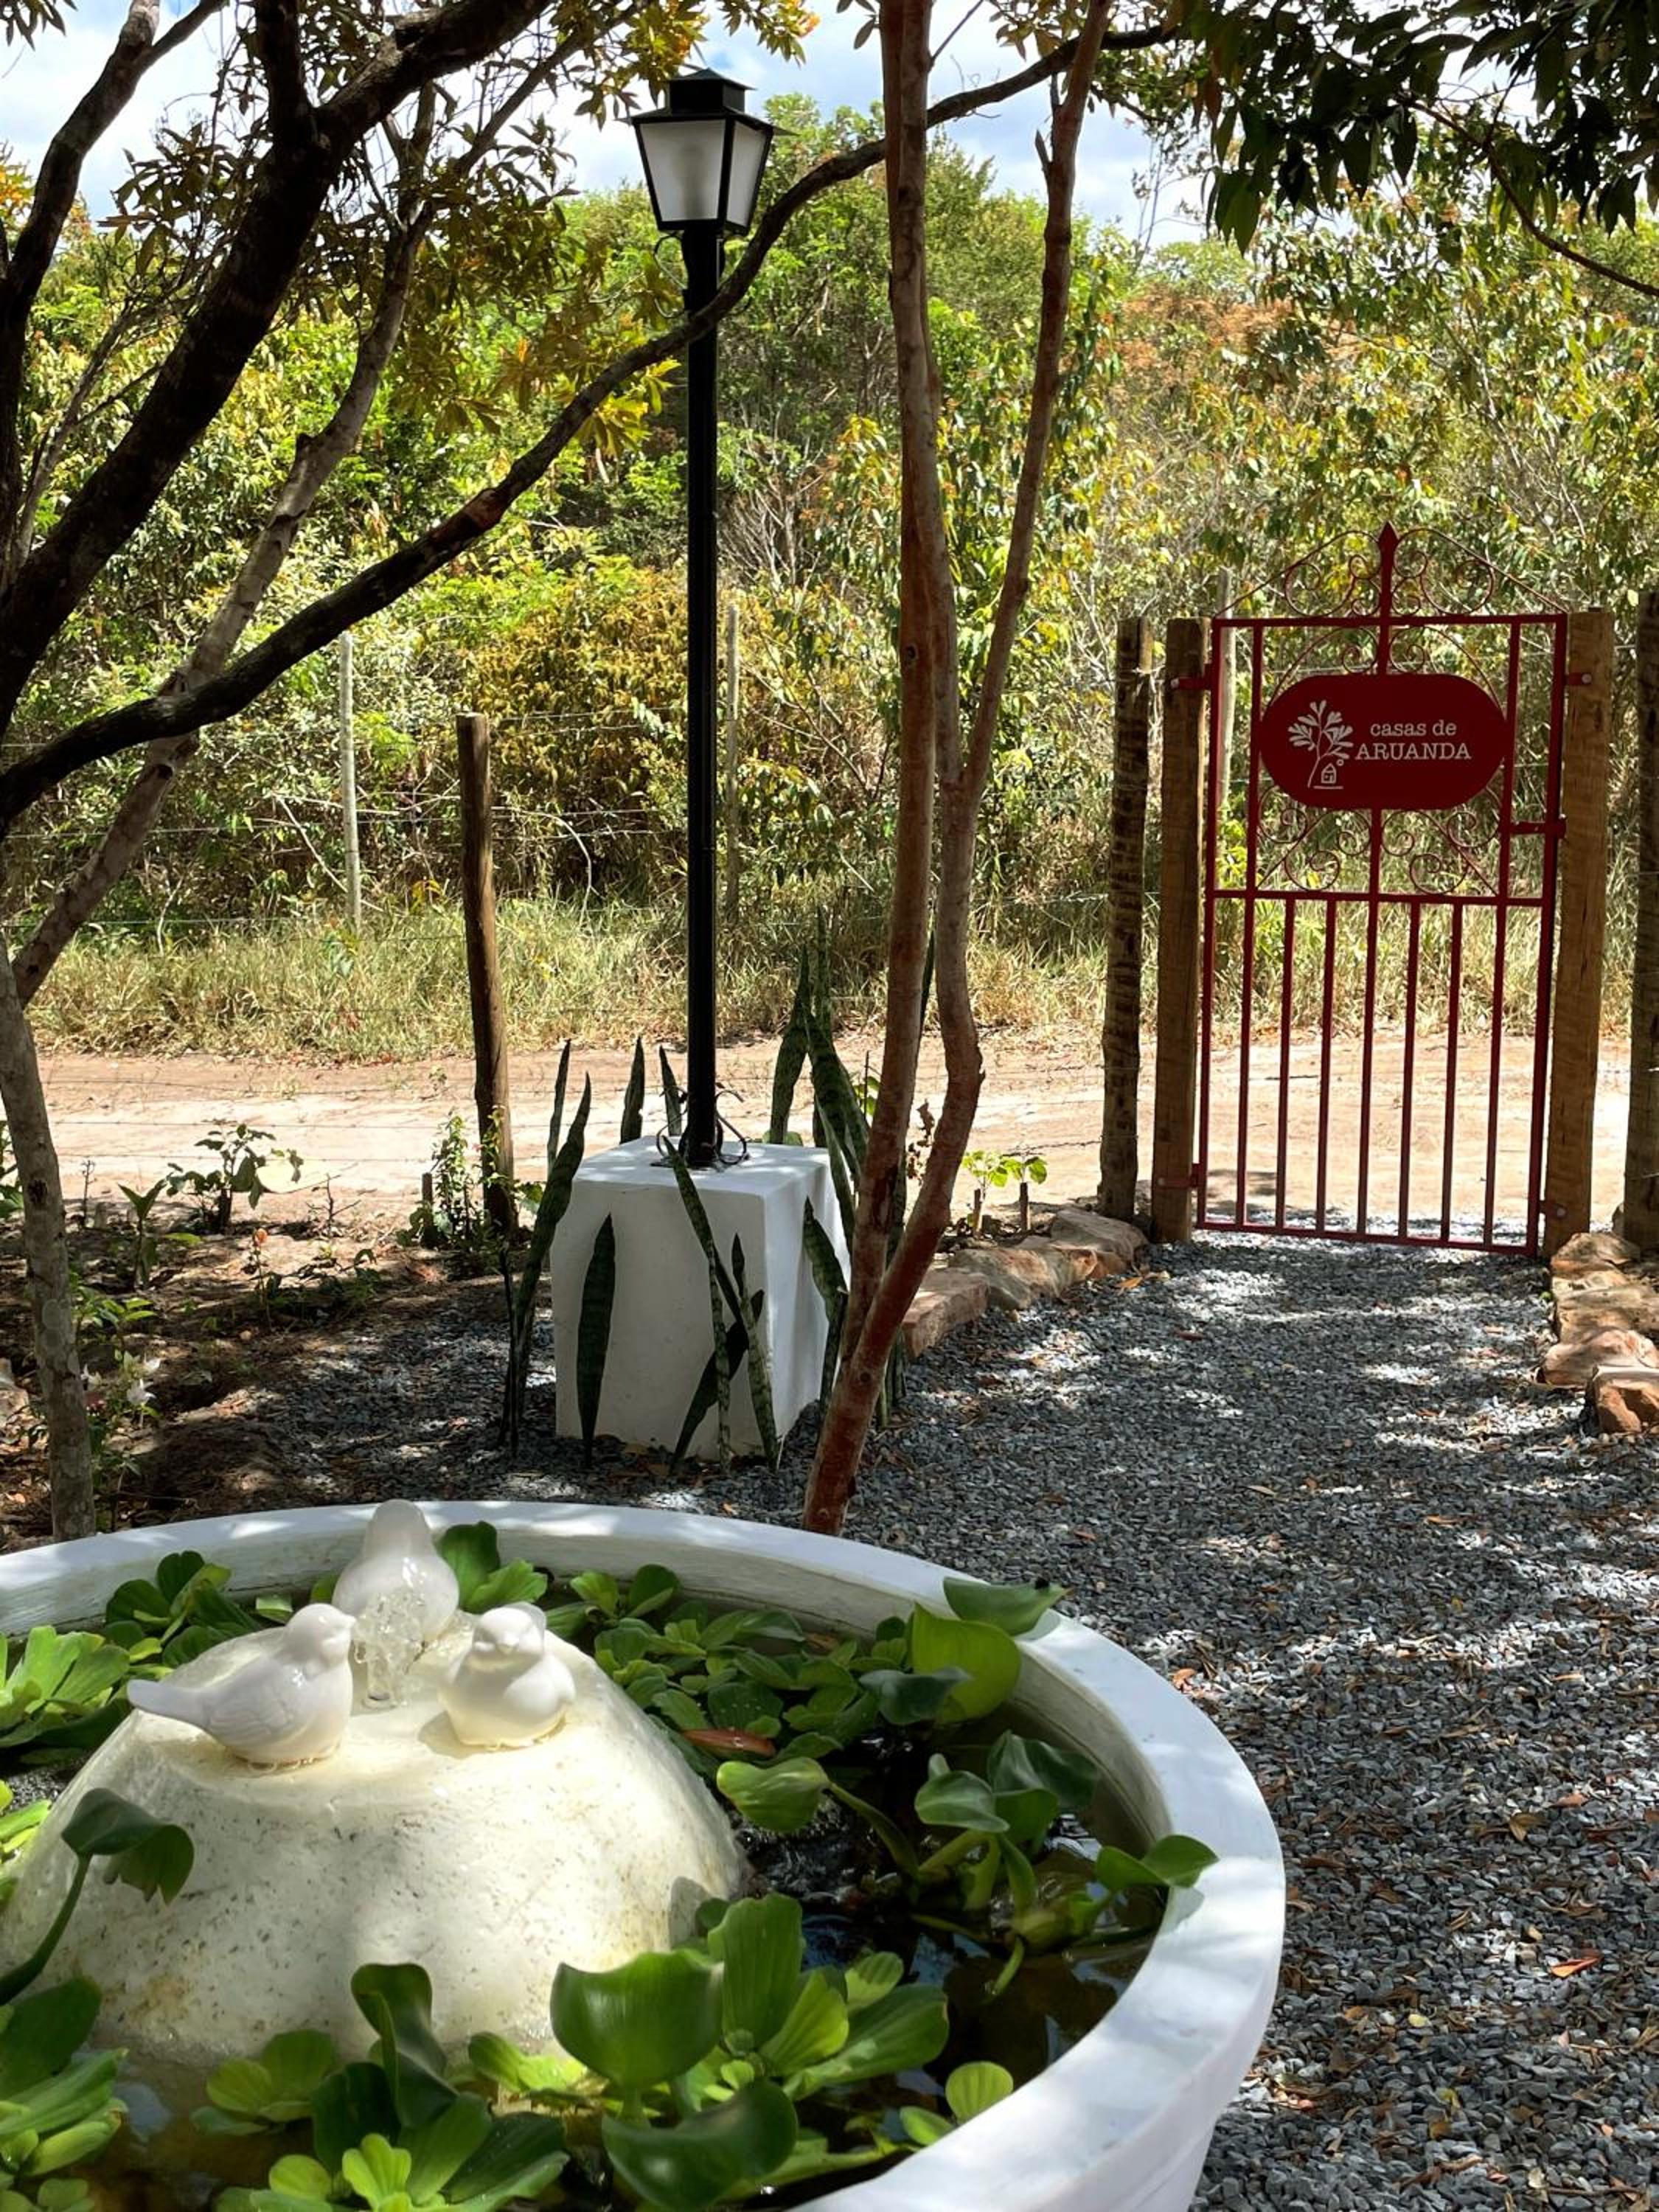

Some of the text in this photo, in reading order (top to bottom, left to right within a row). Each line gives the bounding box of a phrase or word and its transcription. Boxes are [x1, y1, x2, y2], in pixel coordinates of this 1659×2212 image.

[1370, 720, 1456, 736] casas de
[1355, 742, 1471, 759] ARUANDA
